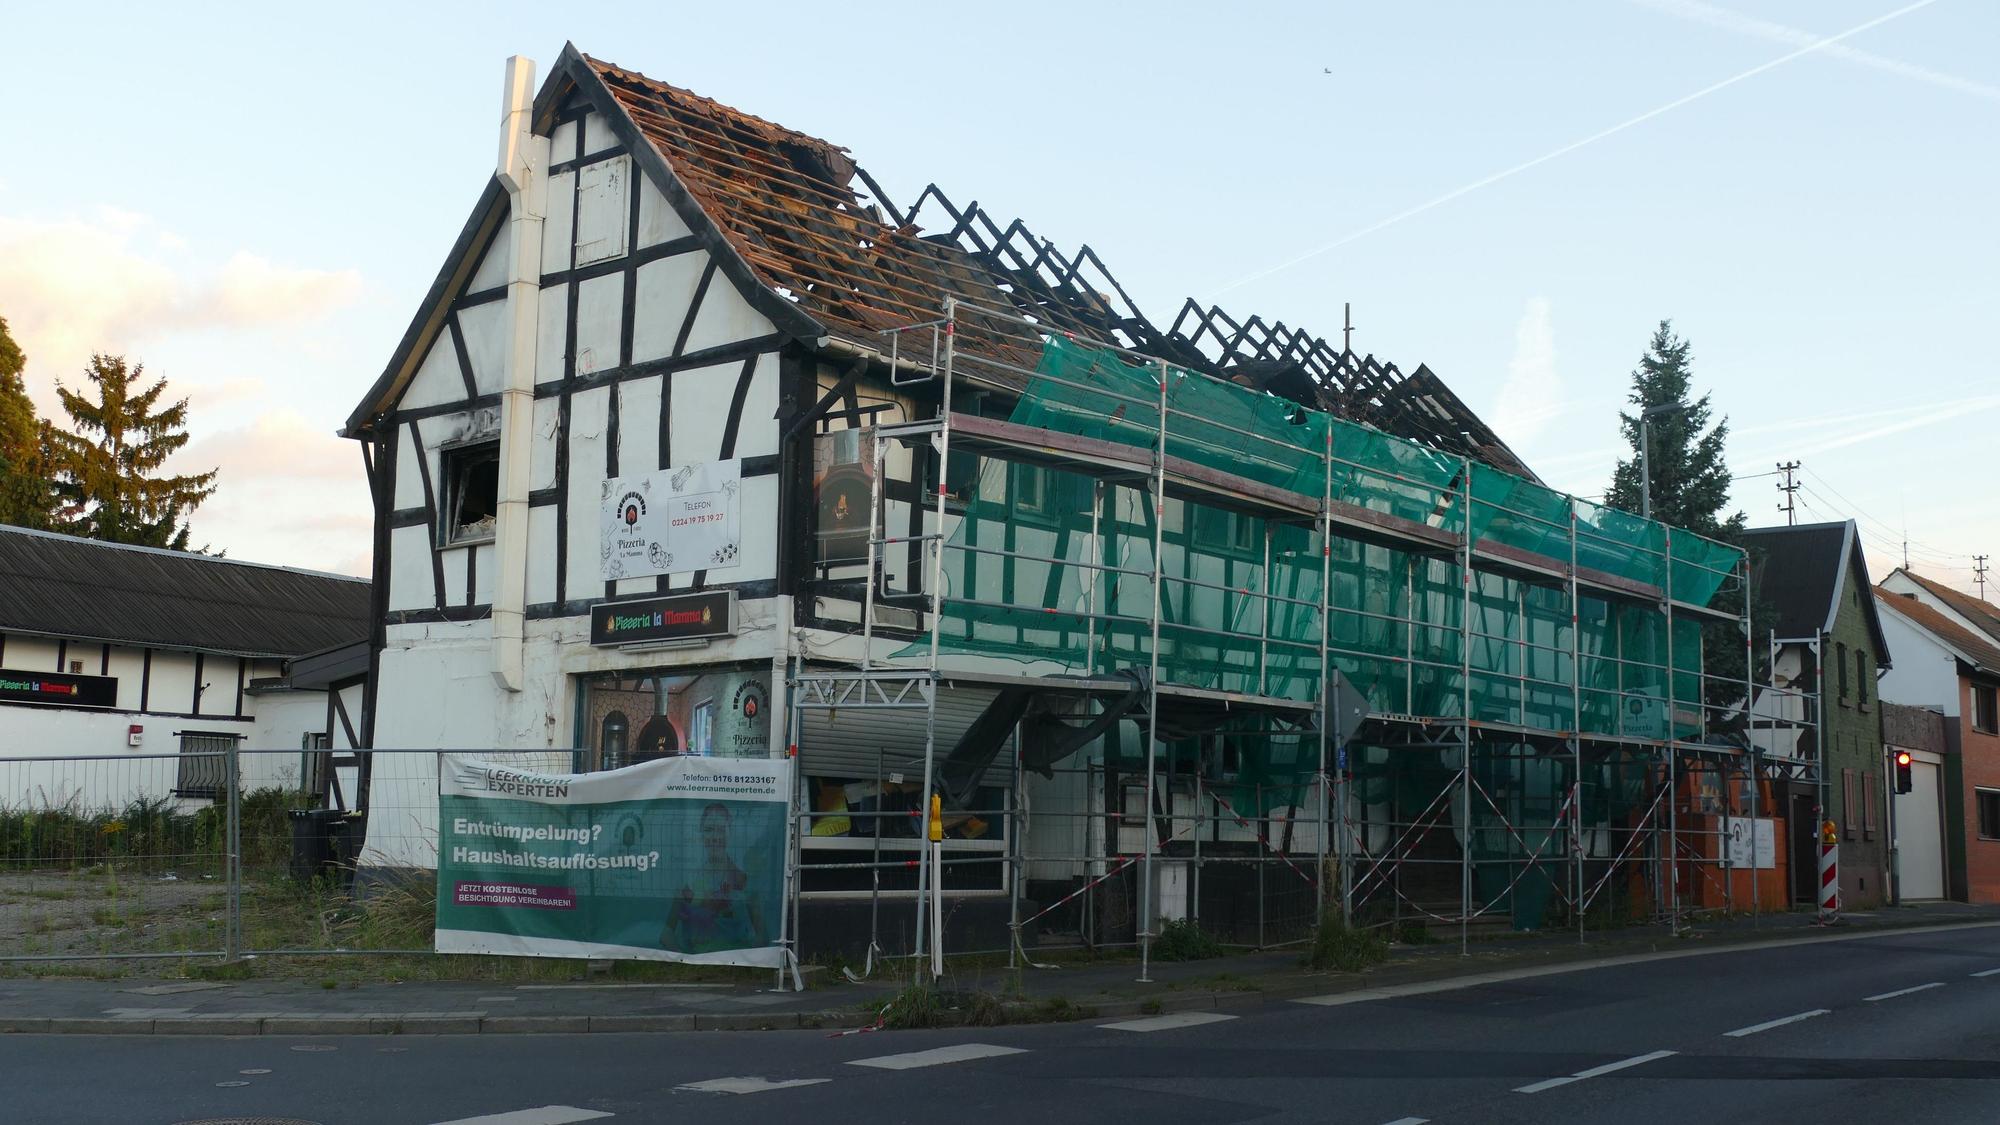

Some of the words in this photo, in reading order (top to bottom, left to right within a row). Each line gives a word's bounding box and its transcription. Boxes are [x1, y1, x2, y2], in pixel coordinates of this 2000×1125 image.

[671, 518, 688, 527] 0224
[689, 517, 696, 525] 19
[698, 515, 706, 523] 75
[707, 514, 714, 522] 19
[716, 513, 724, 521] 27
[617, 538, 645, 550] Pizzeria
[615, 614, 650, 631] Pizzeria
[653, 611, 662, 626] la
[732, 734, 767, 745] Pizzeria
[682, 773, 712, 782] Telefon:
[734, 775, 776, 784] 81233167
[488, 780, 568, 798] EXPERTEN
[667, 784, 776, 794] www.leerraumexperten.de
[453, 818, 602, 845] Entrümpelung?
[453, 846, 659, 872] Haushaltsauflösung?
[458, 884, 481, 892] JETZT
[483, 885, 537, 896] KOSTENLOSE
[458, 894, 517, 903] BESICHTIGUNG
[518, 896, 571, 907] VEREINBAREN!
